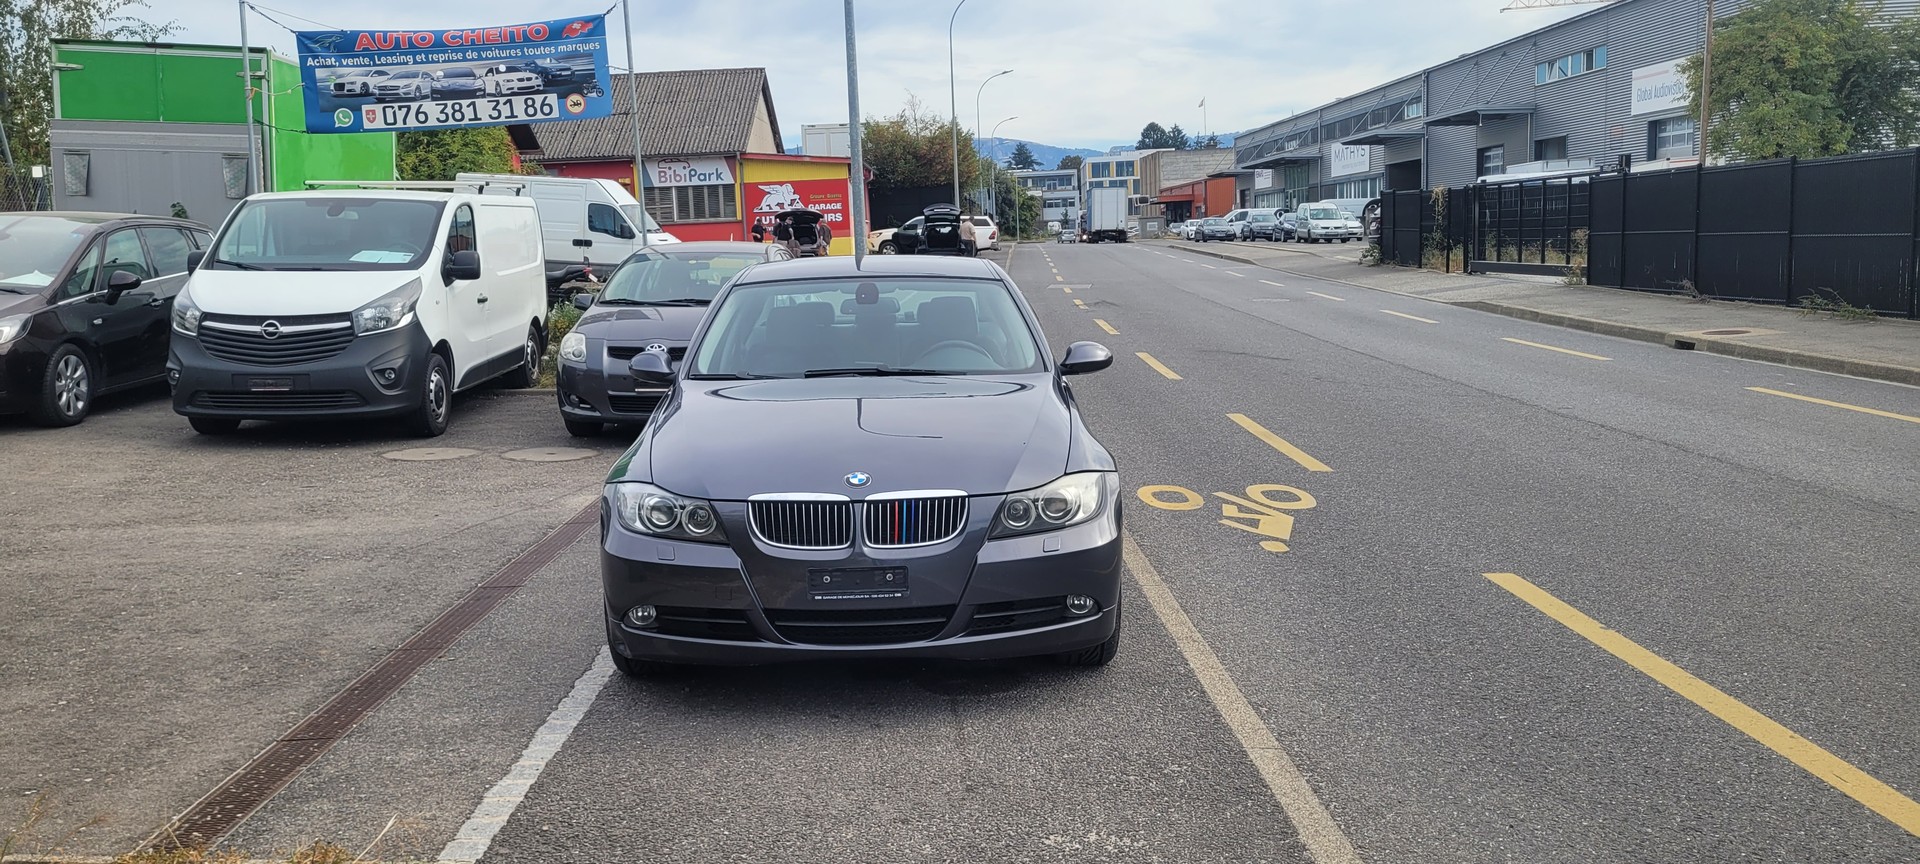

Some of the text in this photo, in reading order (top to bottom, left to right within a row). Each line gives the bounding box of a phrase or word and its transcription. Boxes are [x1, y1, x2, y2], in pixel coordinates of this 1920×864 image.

[356, 24, 549, 51] AUTO CHEITO
[307, 41, 600, 67] Achat, vente, Leasing et reprise de voitures toutes marques
[1637, 86, 1653, 102] Global
[382, 96, 553, 126] 076 381 31 86
[1334, 145, 1365, 162] MATHYS
[658, 168, 724, 184] BibiPark
